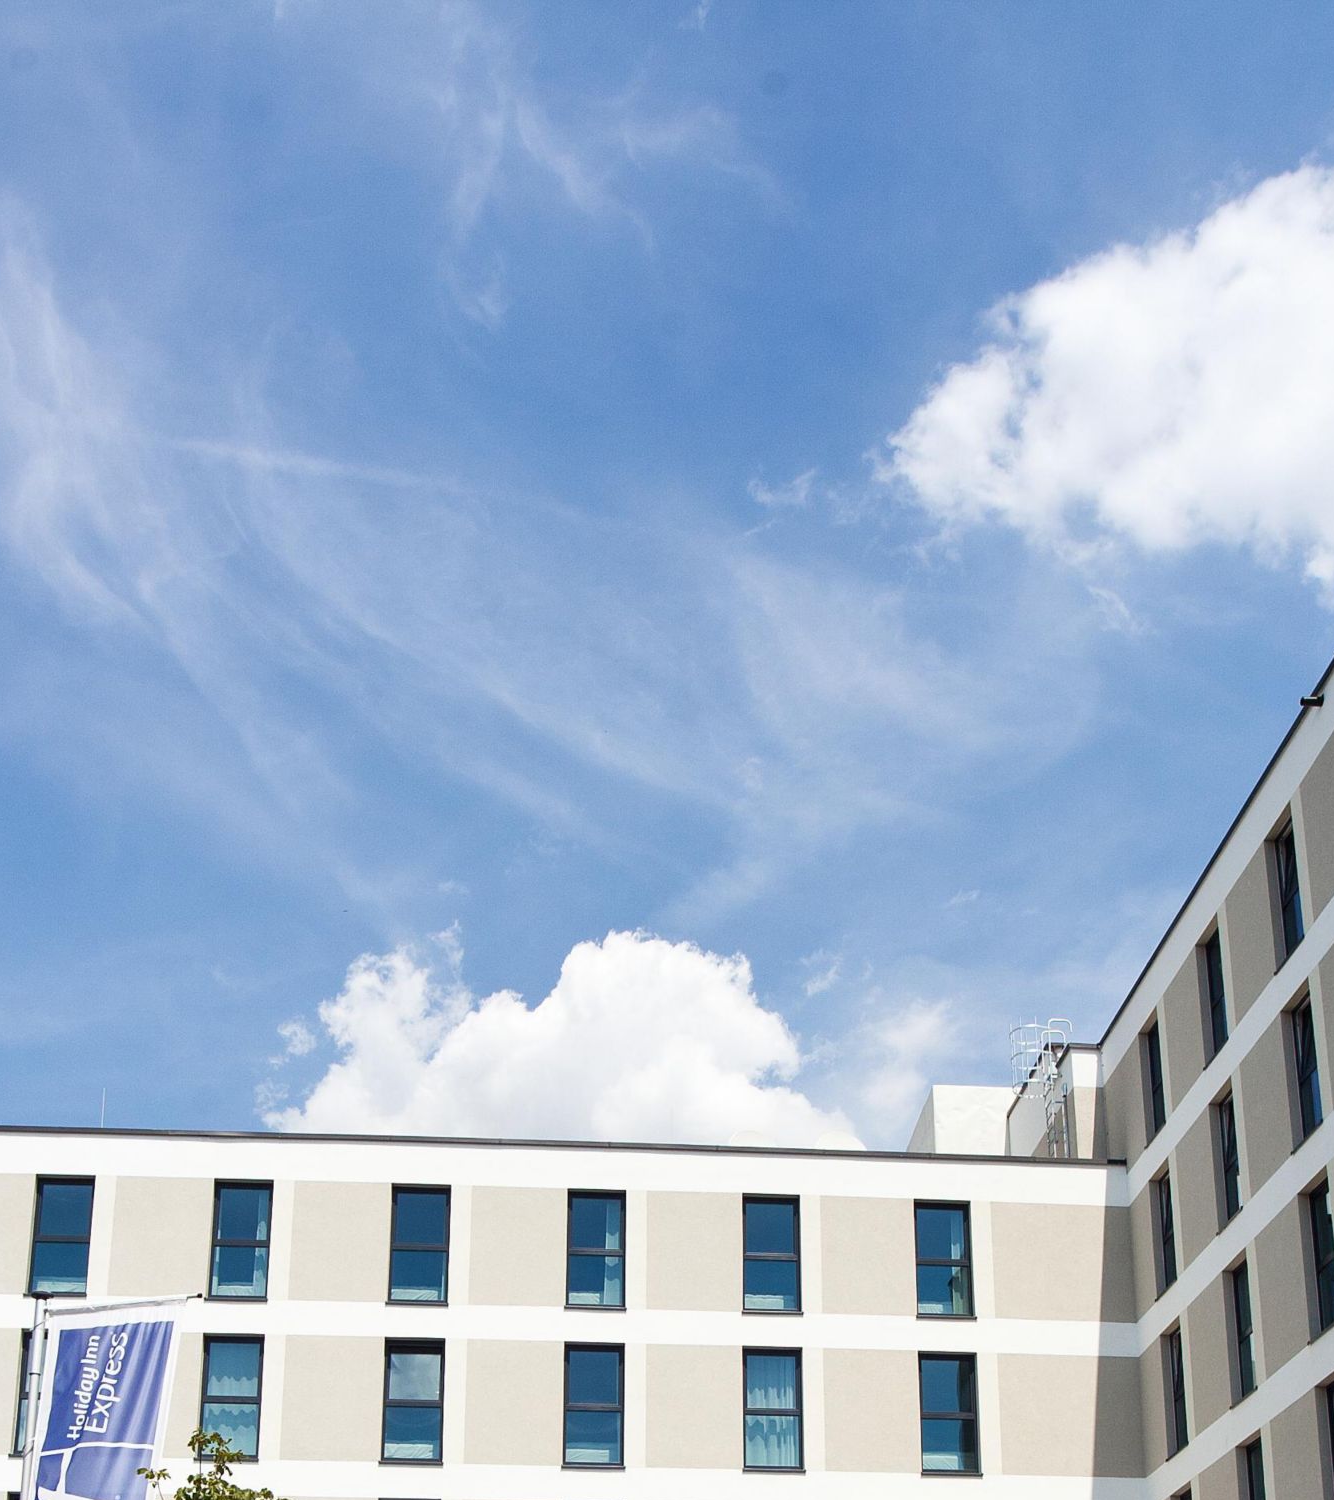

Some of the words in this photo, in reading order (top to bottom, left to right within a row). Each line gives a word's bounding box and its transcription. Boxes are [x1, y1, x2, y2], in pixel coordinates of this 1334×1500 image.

[80, 1335, 101, 1365] Inn
[83, 1331, 129, 1433] Express
[66, 1366, 100, 1441] Holiday
